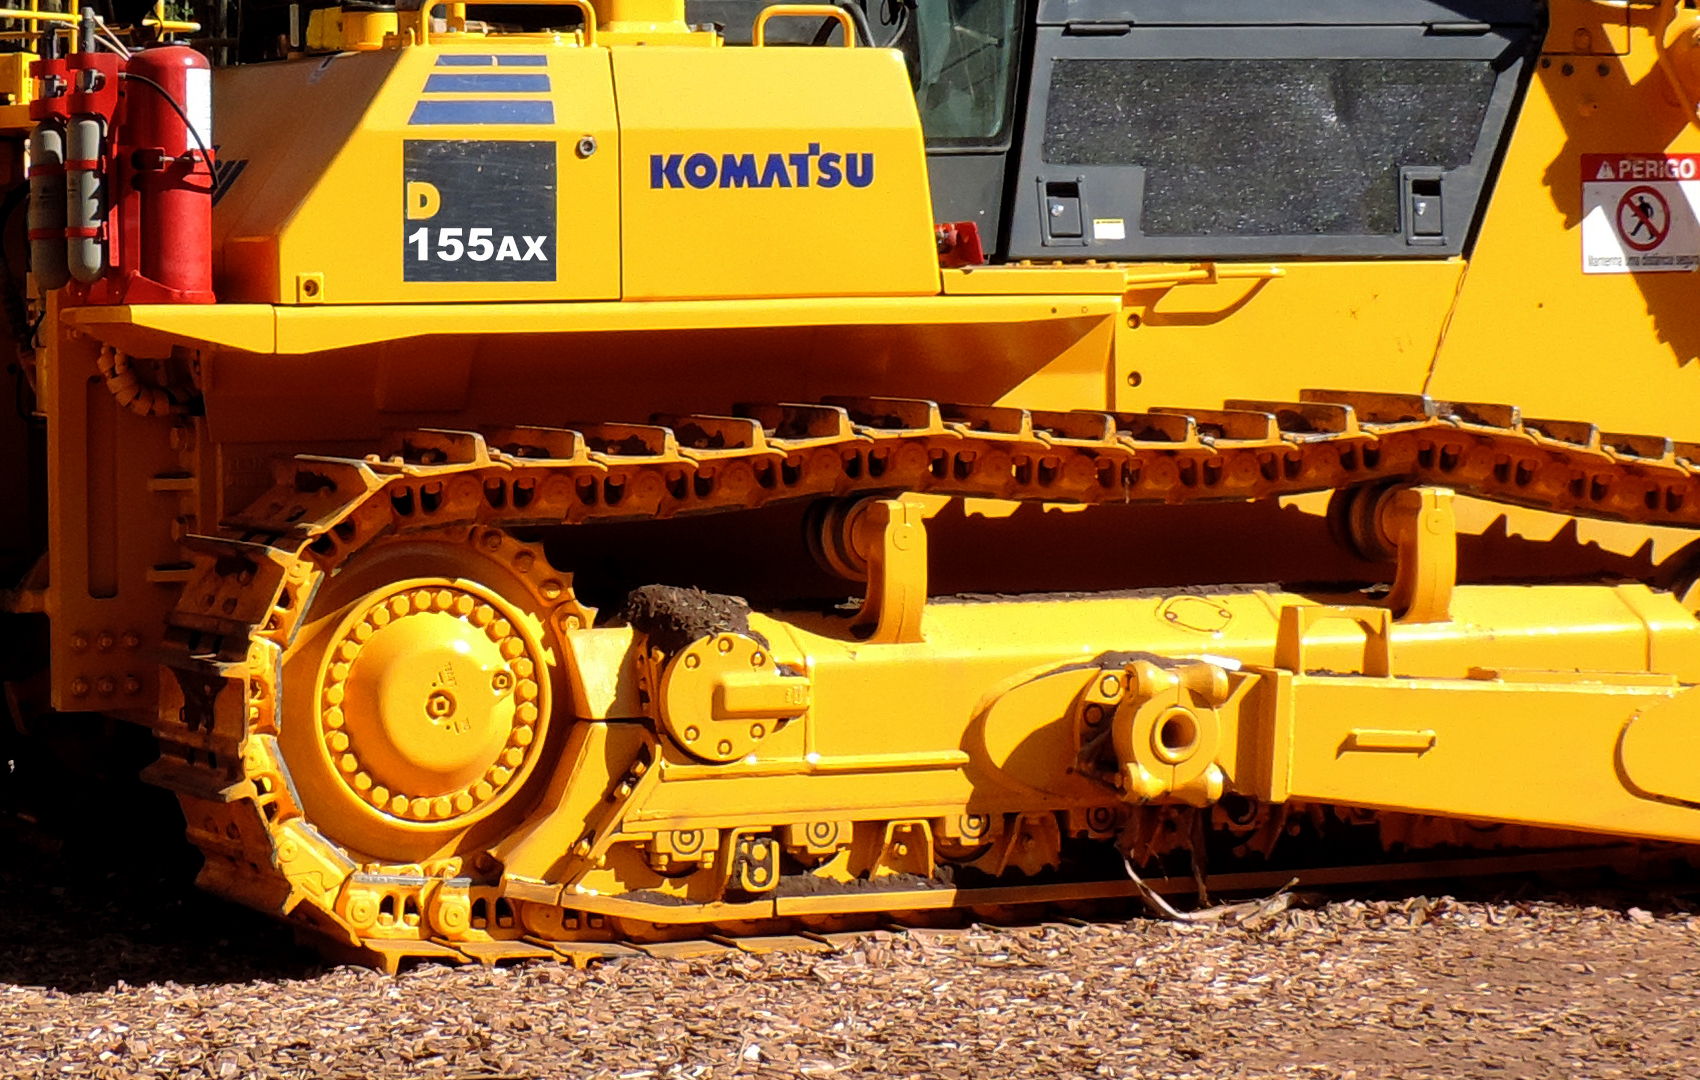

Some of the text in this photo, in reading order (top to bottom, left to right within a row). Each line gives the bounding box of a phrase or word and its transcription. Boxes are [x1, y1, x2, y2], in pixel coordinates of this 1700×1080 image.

[650, 143, 874, 188] KOMATSU
[1619, 158, 1695, 178] PERIGO
[407, 182, 440, 219] D
[409, 227, 548, 261] 155AX
